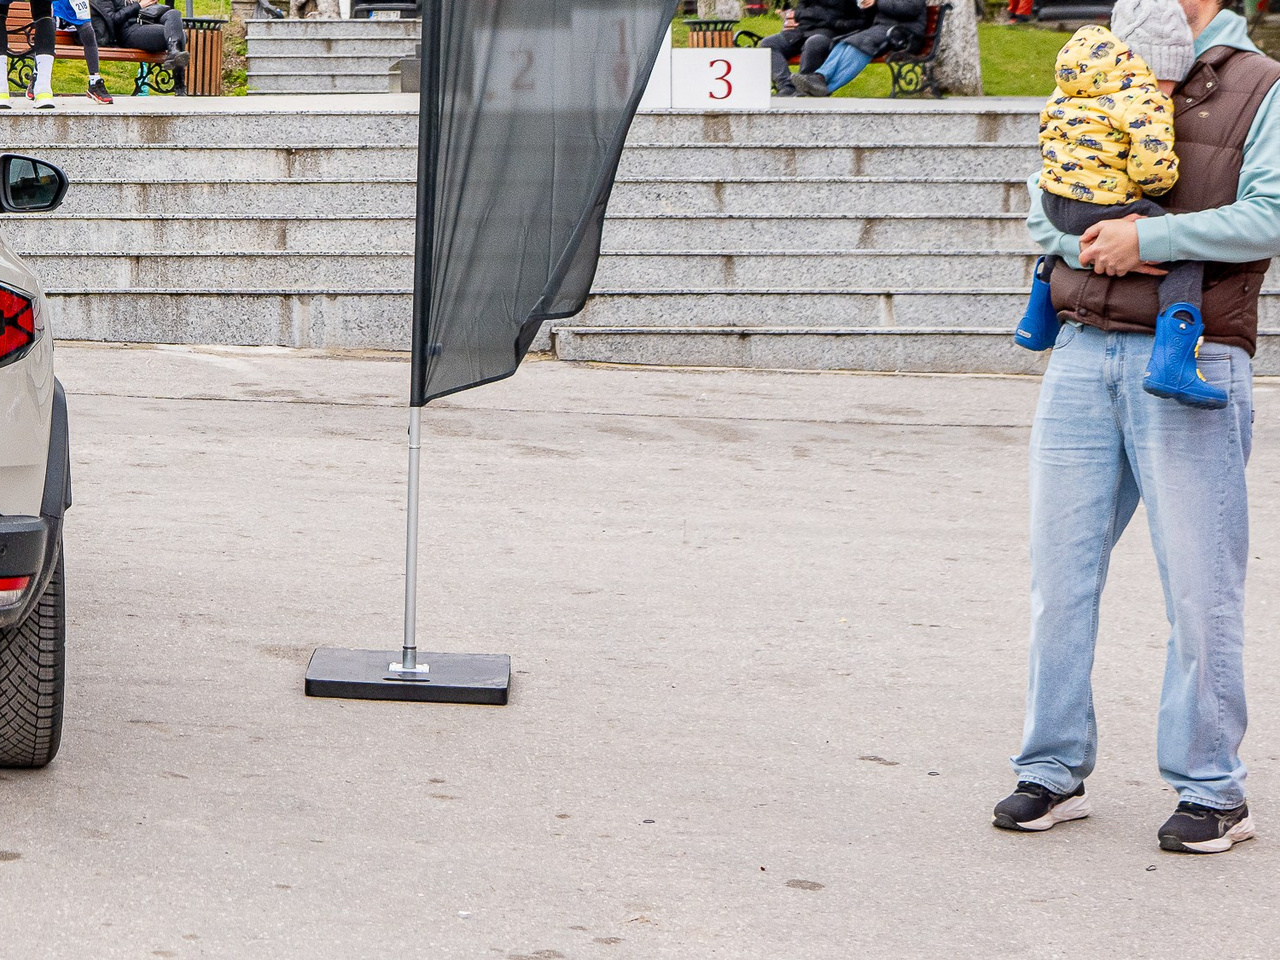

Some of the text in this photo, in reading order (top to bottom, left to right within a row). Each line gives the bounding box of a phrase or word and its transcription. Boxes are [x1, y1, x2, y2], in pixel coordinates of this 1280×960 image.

[75, 1, 88, 11] 218
[508, 49, 536, 91] 2
[709, 59, 732, 99] 3
